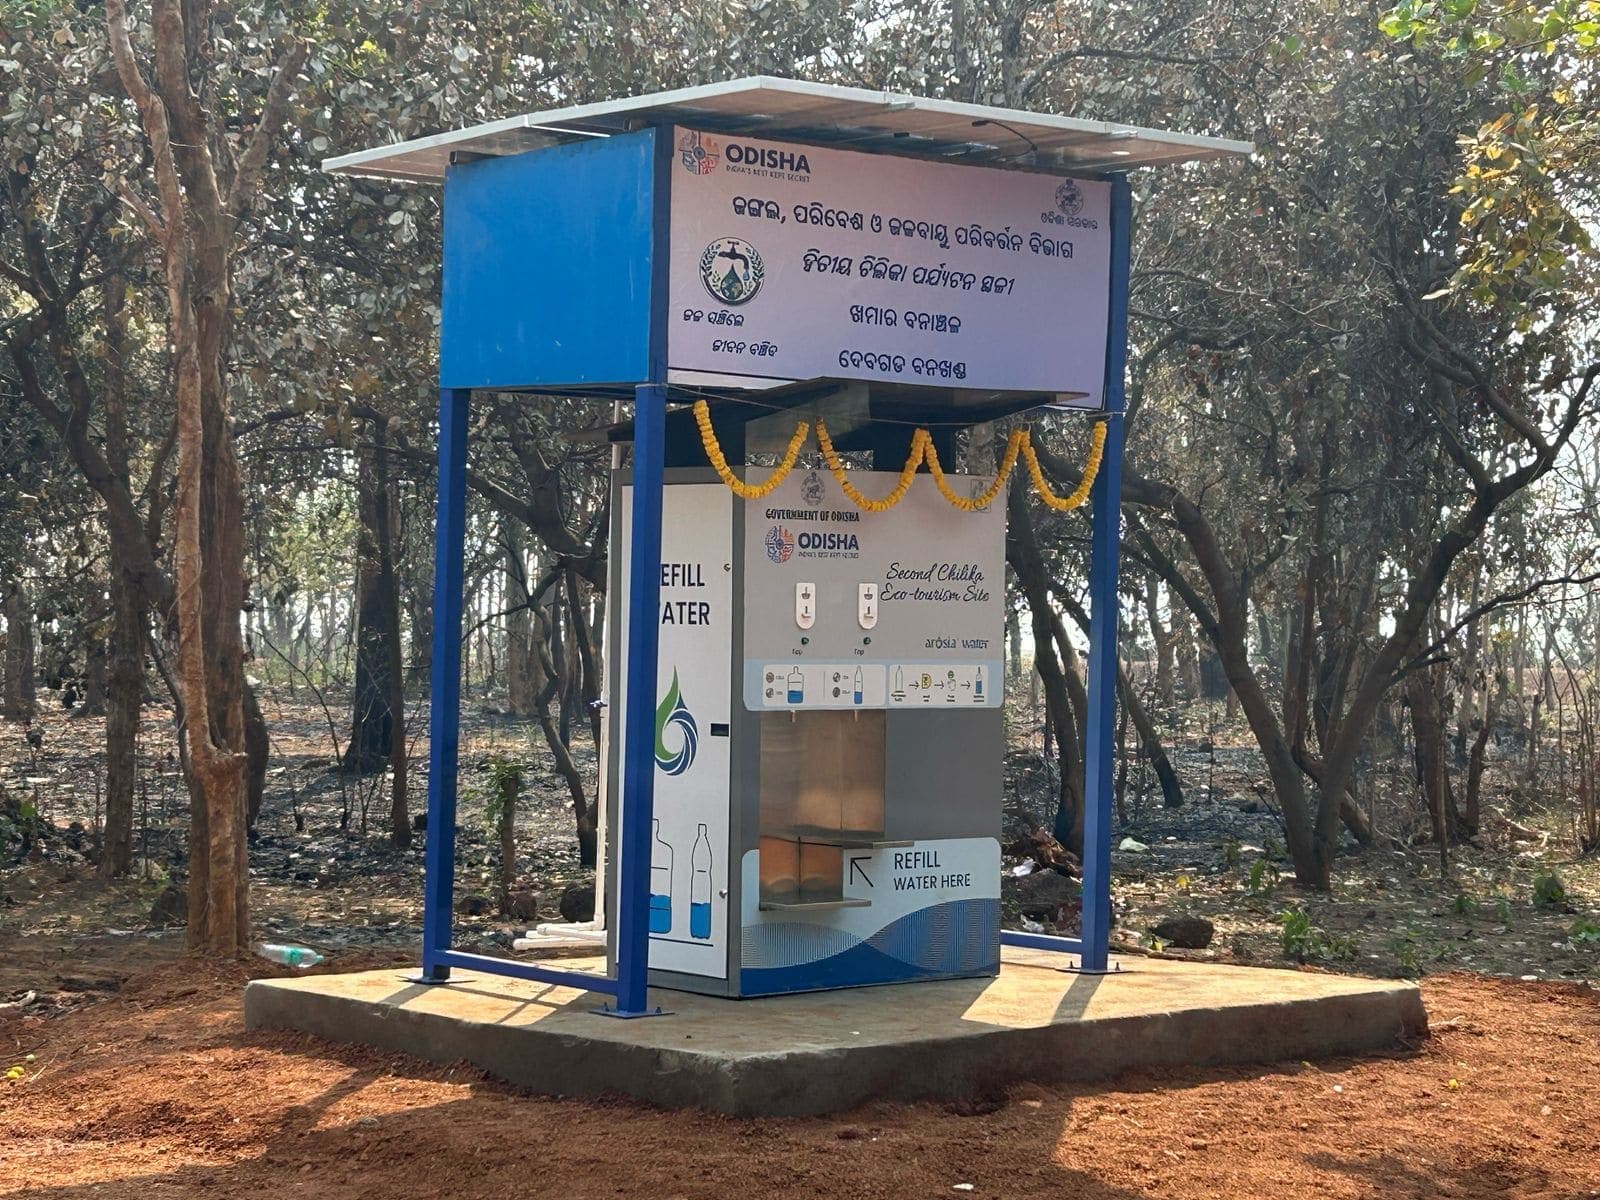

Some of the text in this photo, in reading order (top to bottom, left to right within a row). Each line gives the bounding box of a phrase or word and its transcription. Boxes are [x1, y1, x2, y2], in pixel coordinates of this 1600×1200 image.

[725, 143, 811, 174] ODISHA
[793, 202, 864, 231] ପରିବେଶ
[870, 213, 882, 233] ଓ
[888, 217, 950, 249] ଜଳବାୟୁ
[1029, 232, 1073, 259] ବିଭାଗ
[850, 304, 897, 327] ଖମାର
[766, 508, 860, 522] GOVERNMENT OF ODISHA
[798, 532, 859, 550] ODISHA
[660, 564, 705, 587] EFILL
[886, 562, 985, 584] Second Chilika
[880, 583, 989, 602] Eco-tourism Site
[661, 602, 710, 625] ATER
[894, 851, 941, 870] REFILL
[894, 873, 970, 890] WATER HERE
